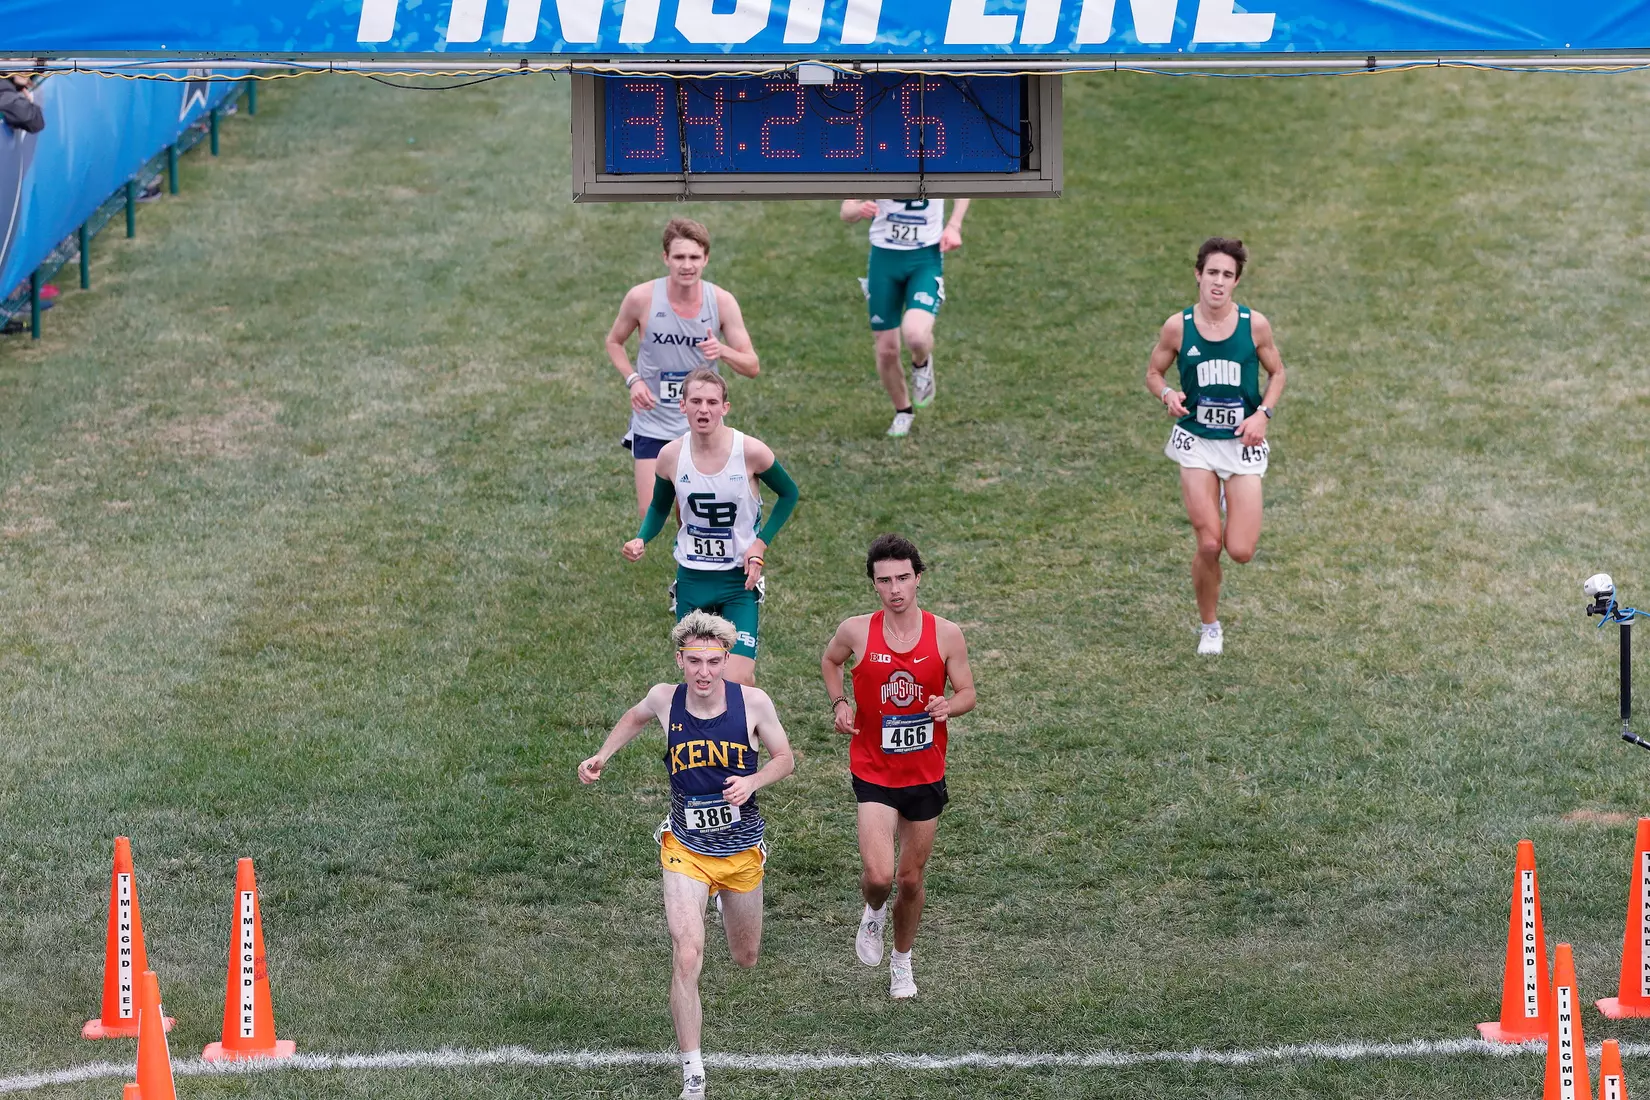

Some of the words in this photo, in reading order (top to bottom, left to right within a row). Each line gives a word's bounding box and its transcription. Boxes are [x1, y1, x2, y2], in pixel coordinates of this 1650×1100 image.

[891, 224, 919, 241] 521
[652, 332, 709, 348] XAVIE
[1196, 359, 1242, 388] OHIO
[1204, 408, 1237, 425] 456
[694, 537, 726, 557] 513
[890, 725, 927, 747] 466
[670, 739, 748, 775] KENT
[693, 805, 733, 829] 386
[120, 874, 131, 1016] TIMINGMD.NET
[1524, 872, 1537, 1016] TIMINGMD.NET
[243, 893, 253, 1036] TIMINGMD.NET
